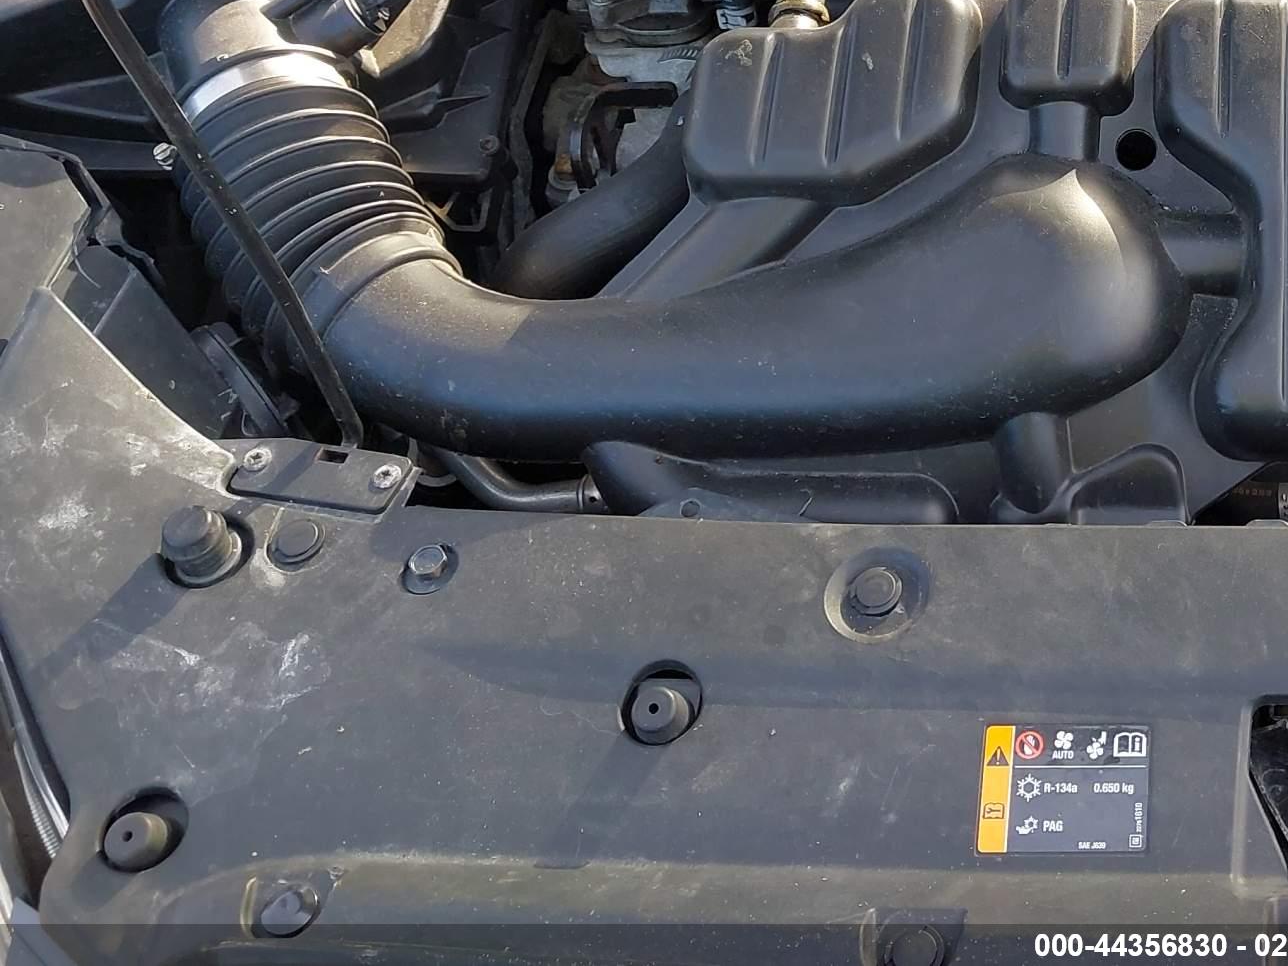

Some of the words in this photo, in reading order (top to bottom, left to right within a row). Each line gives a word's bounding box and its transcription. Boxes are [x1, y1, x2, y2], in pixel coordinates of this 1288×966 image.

[1052, 750, 1074, 759] AUTO
[1043, 783, 1078, 793] R-134a
[1093, 783, 1120, 793] 0.650
[1121, 783, 1134, 795] kg
[1042, 820, 1063, 832] PAG
